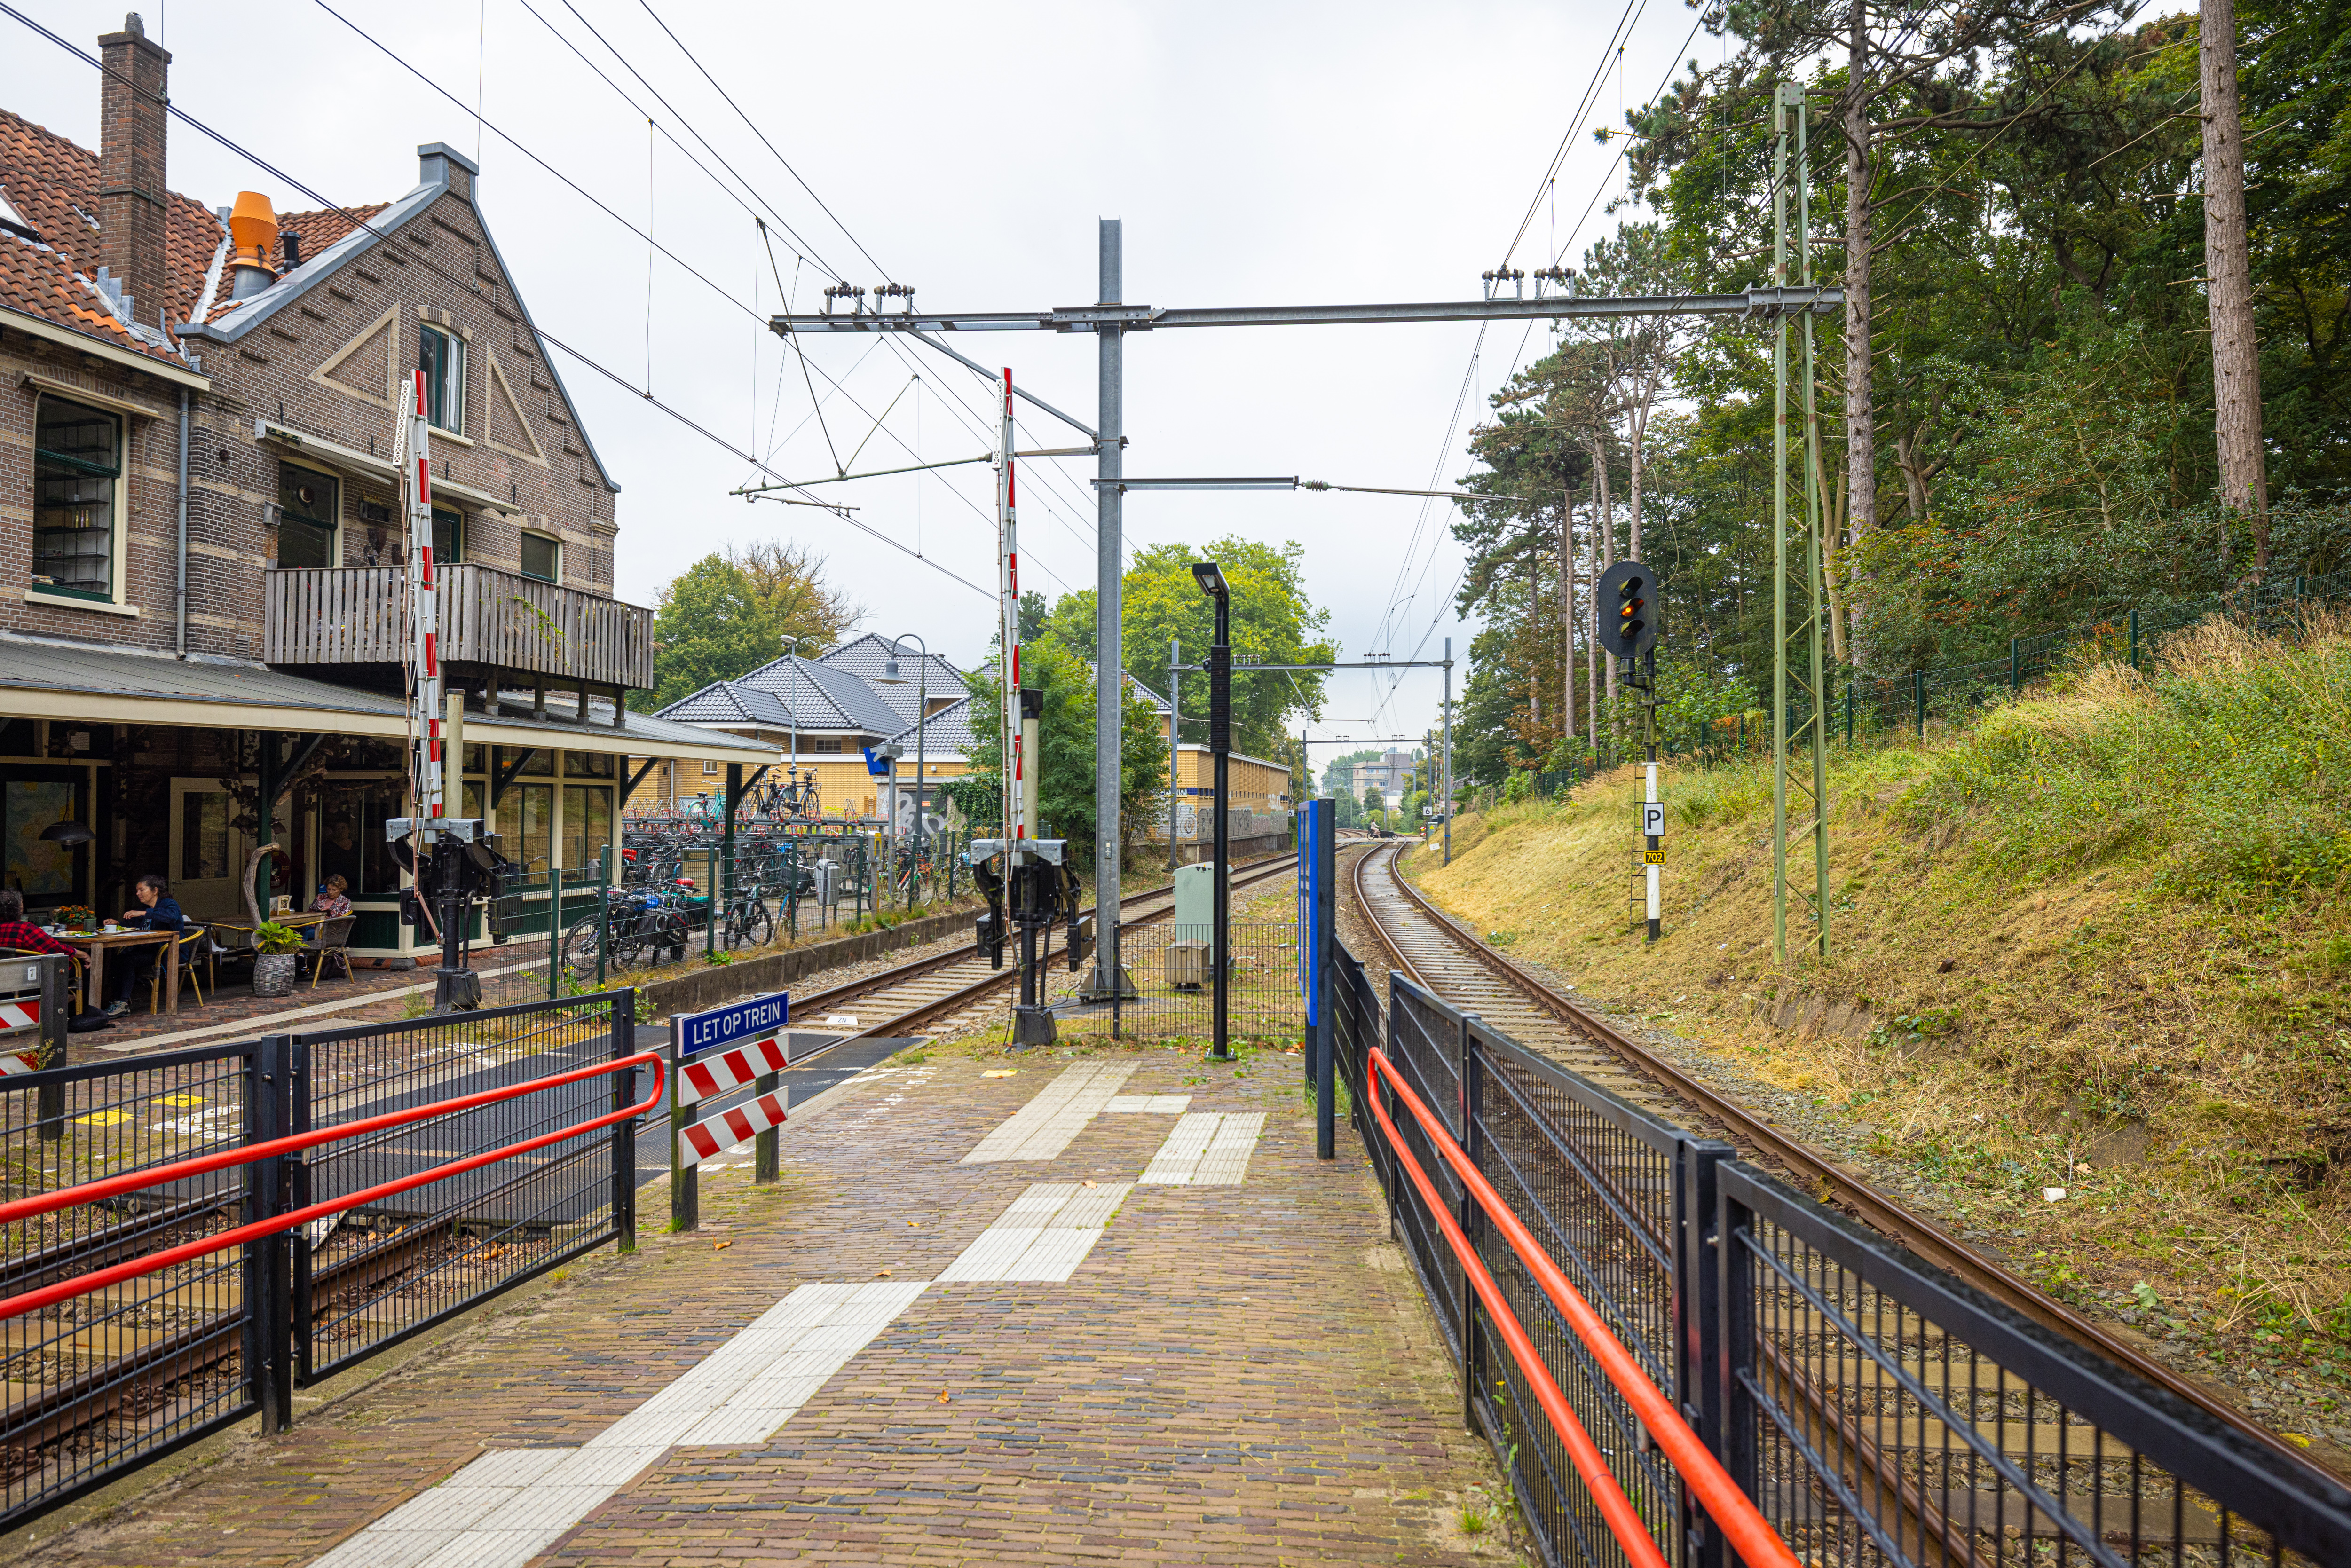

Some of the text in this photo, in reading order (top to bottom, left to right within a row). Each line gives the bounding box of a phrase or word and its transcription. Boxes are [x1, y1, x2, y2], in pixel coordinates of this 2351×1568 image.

[1647, 810, 1661, 829] P
[1647, 852, 1663, 862] 702
[694, 1001, 780, 1045] LET OP TREIN
